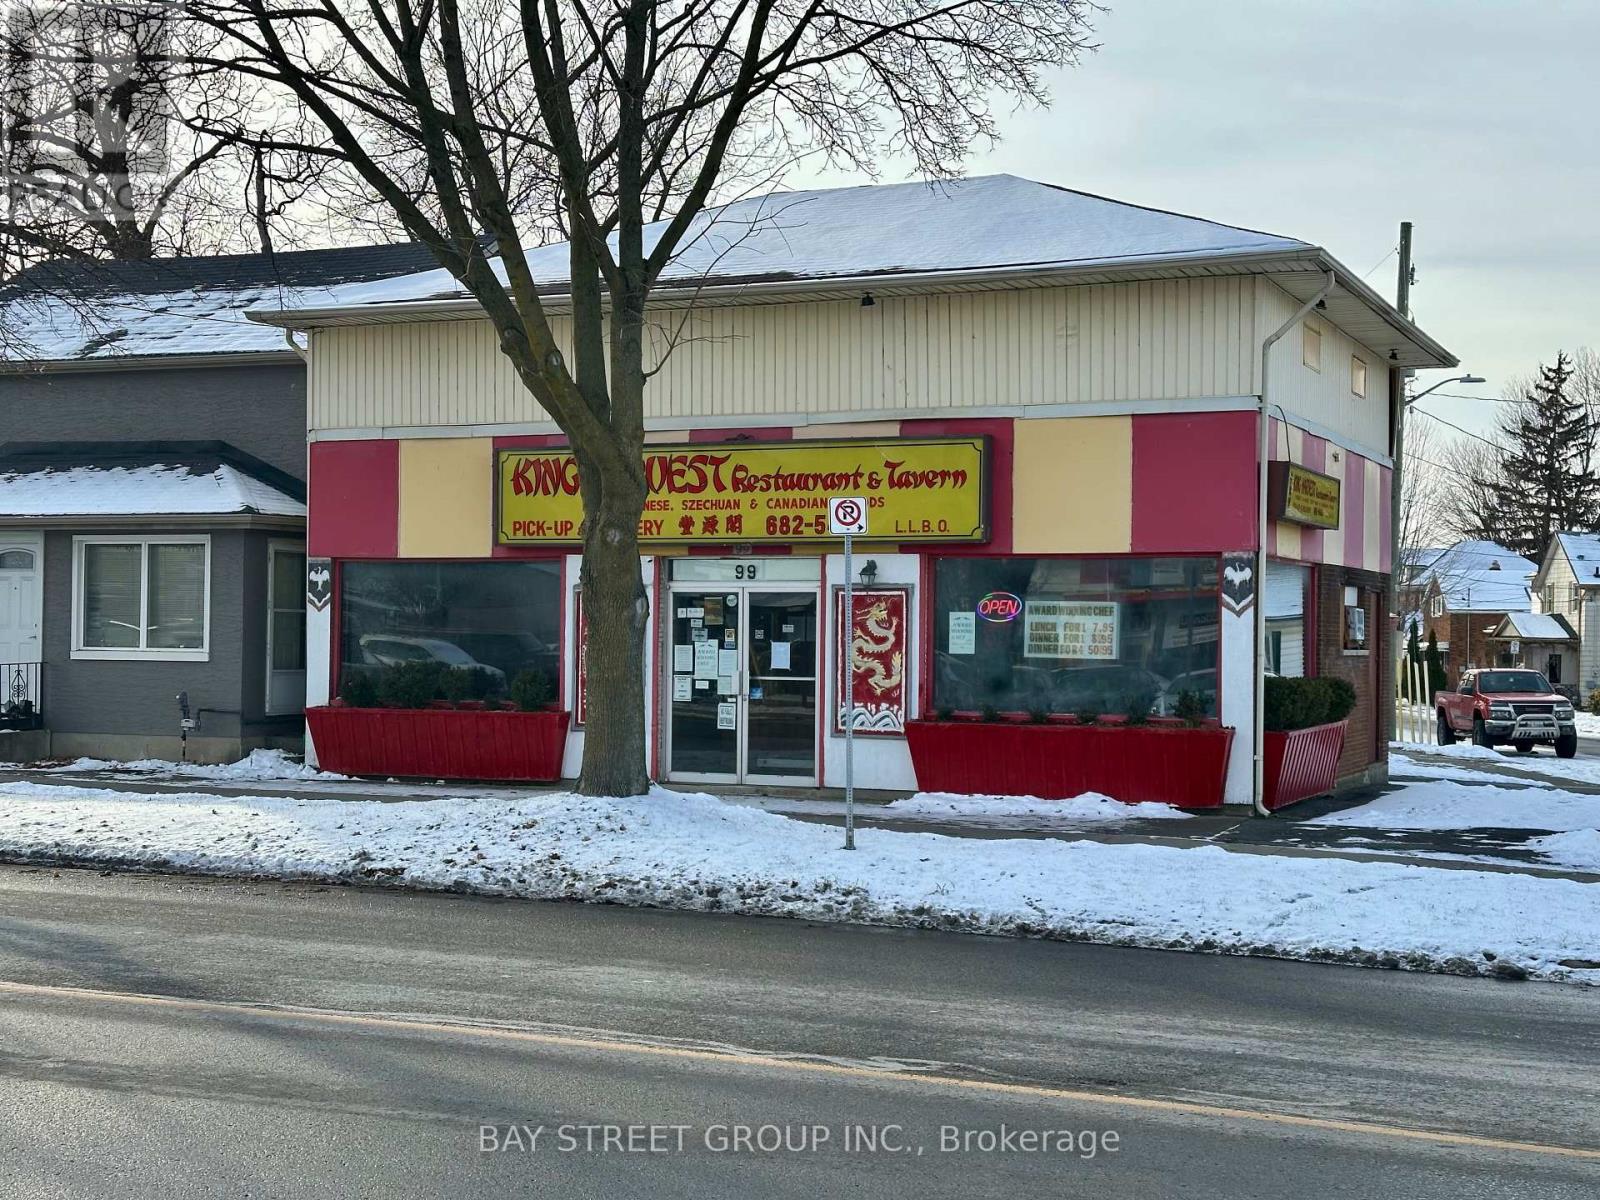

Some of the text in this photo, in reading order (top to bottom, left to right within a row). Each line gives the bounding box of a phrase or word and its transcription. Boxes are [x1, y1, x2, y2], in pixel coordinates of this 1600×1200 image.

[643, 453, 732, 495] UEST
[731, 464, 864, 493] Restaurant
[867, 472, 882, 490] &
[884, 460, 967, 490] Tavern
[682, 499, 741, 511] SZECHUAN
[749, 499, 758, 510] &
[767, 498, 828, 511] CANADIAN
[512, 519, 573, 537] PICK-UP
[765, 514, 829, 535] 682-5
[735, 565, 756, 580] 99
[980, 599, 1018, 615] OPEN
[1093, 606, 1114, 617] CHEF
[1029, 632, 1059, 643] DINNER
